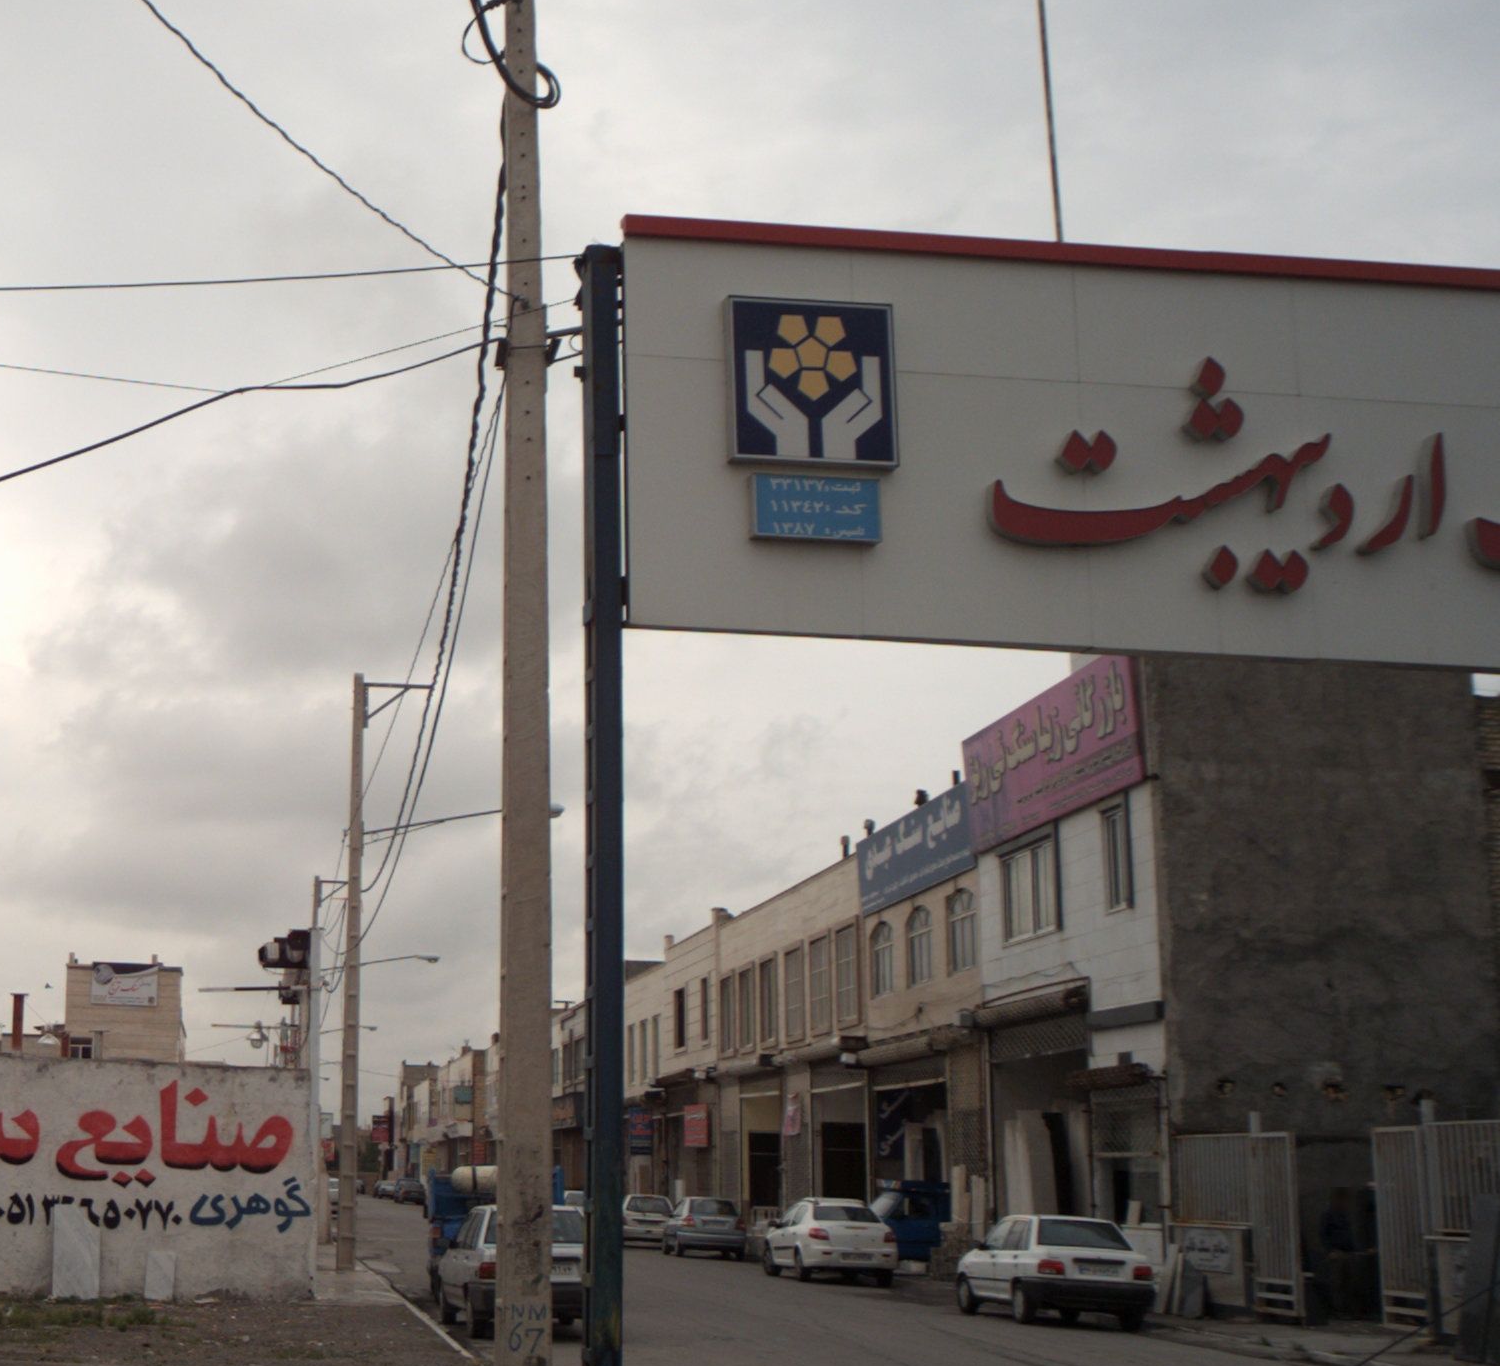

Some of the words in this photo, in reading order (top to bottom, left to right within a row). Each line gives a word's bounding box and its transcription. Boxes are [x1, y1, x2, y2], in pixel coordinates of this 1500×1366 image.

[987, 355, 1447, 596] اردیبهشت
[55, 1079, 294, 1189] صنایع
[189, 1176, 312, 1234] گوهری
[507, 1321, 546, 1354] 67
